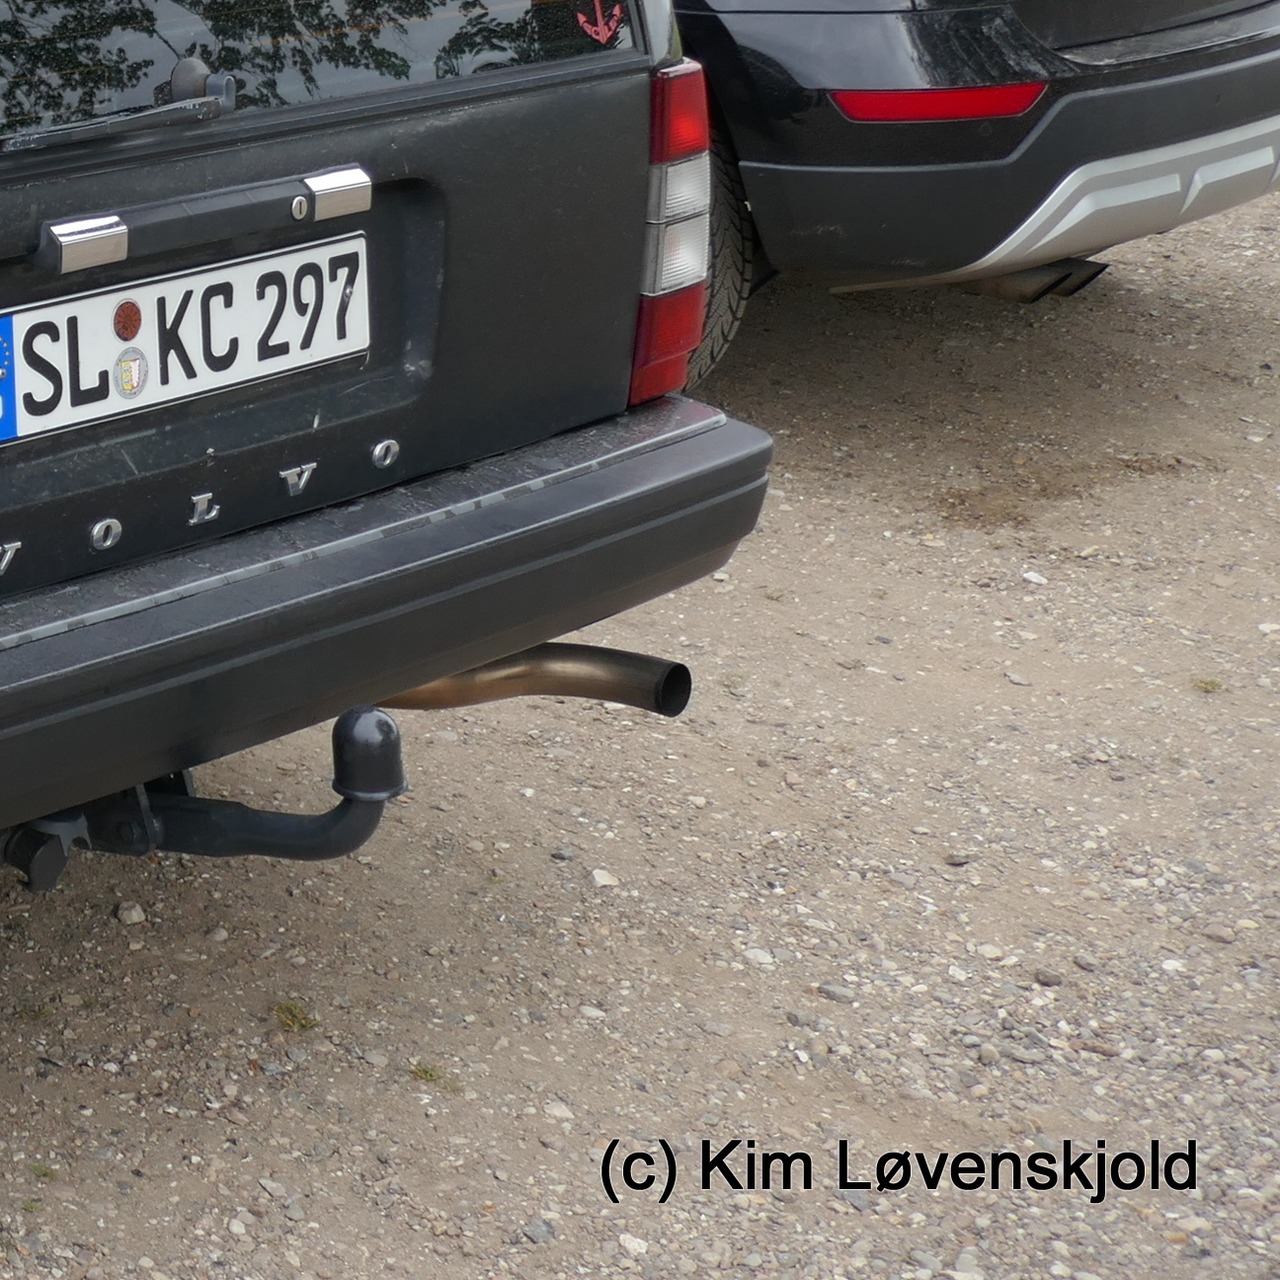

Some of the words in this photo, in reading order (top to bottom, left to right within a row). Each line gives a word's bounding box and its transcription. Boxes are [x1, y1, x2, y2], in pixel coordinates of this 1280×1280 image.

[22, 315, 110, 418] SL
[155, 281, 240, 387] KC
[255, 251, 361, 362] 297
